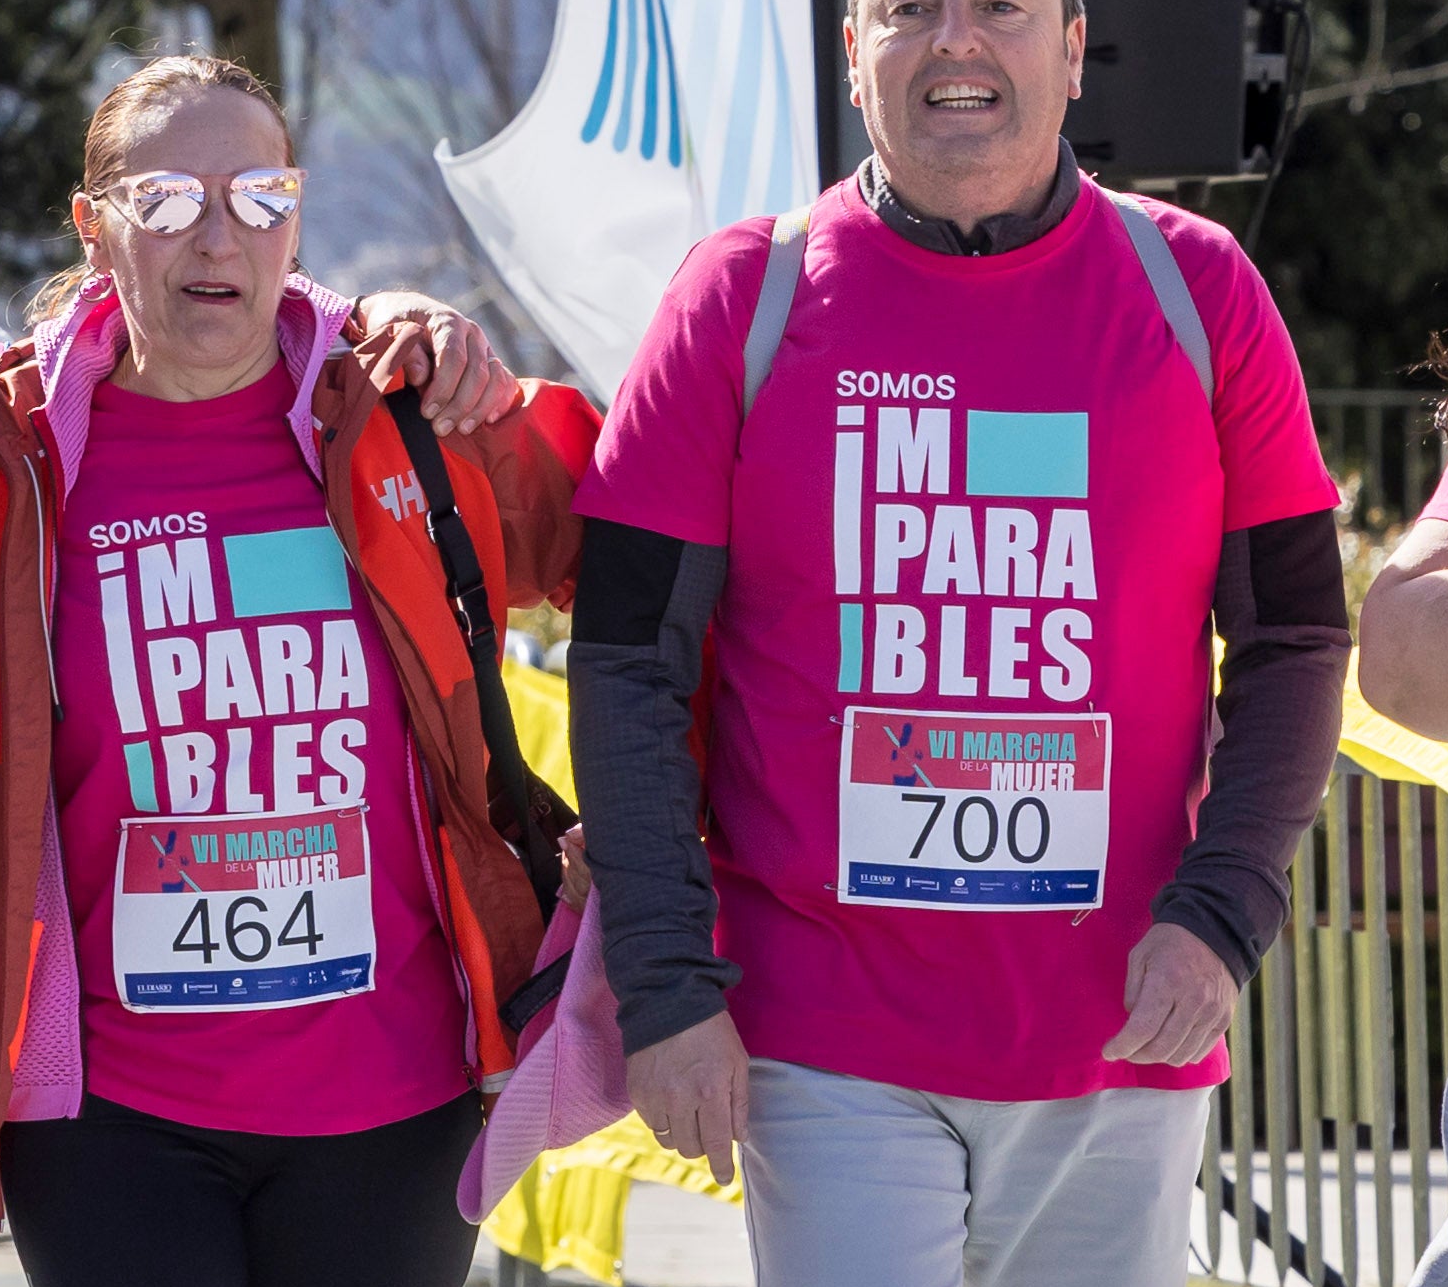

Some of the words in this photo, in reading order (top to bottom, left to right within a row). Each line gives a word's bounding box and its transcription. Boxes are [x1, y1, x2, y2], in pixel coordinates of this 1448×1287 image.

[836, 369, 956, 400] SOMOS
[89, 512, 208, 549] SOMOS
[873, 503, 1097, 600] PARA
[147, 619, 370, 727] PARA
[928, 730, 954, 760] VI
[962, 730, 1076, 762] MARCHA
[960, 761, 974, 771] DE
[976, 762, 989, 772] LA
[990, 761, 1075, 791] MUJER
[191, 835, 219, 865] VI
[226, 823, 338, 863] MARCHA
[900, 793, 1050, 863] 700
[225, 864, 239, 872] DE
[240, 862, 254, 871] LA
[256, 853, 340, 891] MUJER
[172, 890, 324, 964] 464
